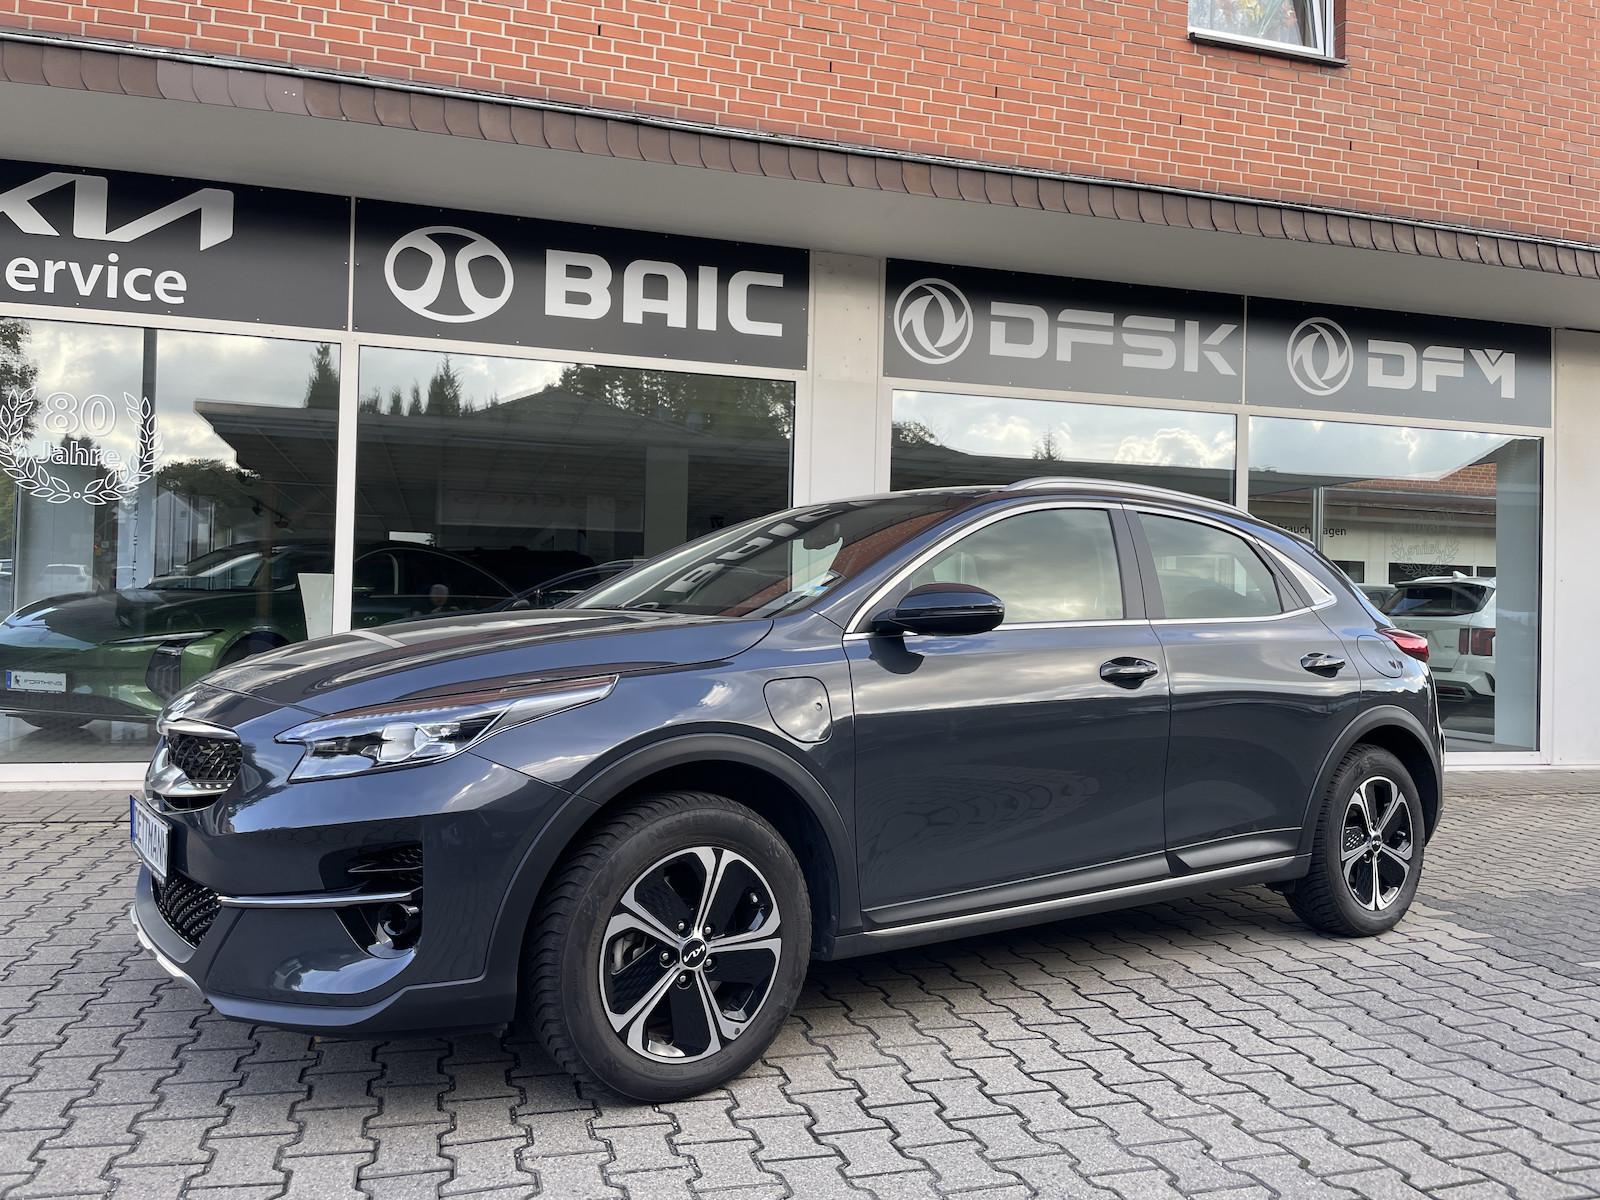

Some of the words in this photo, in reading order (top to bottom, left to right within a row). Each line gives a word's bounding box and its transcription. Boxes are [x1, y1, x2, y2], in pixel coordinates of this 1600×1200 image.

[5, 252, 188, 304] ervice
[545, 248, 784, 337] BAIC
[990, 301, 1238, 376] DFSK
[1367, 339, 1516, 400] DFM
[44, 392, 116, 436] 80
[36, 440, 121, 468] Jahre
